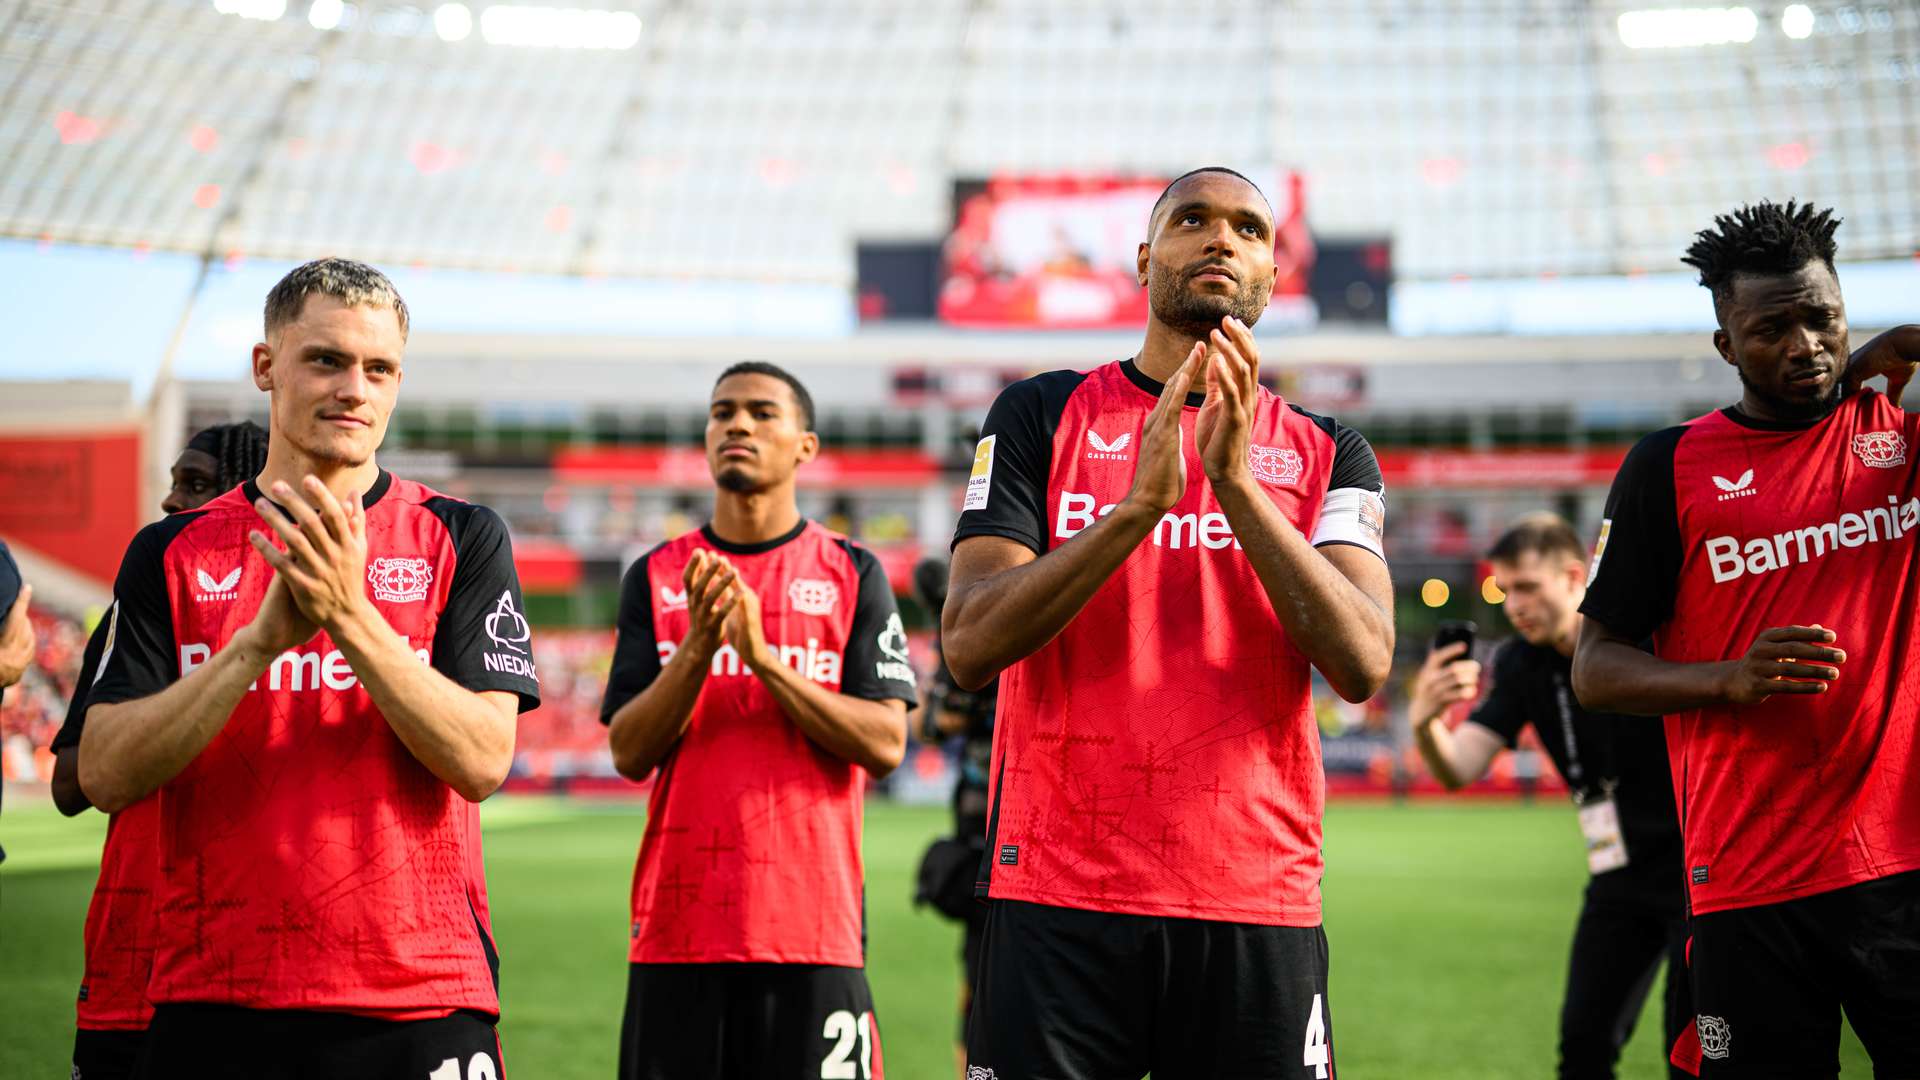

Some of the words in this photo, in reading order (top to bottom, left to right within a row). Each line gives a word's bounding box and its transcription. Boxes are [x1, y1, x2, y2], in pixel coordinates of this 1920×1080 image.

[1088, 452, 1128, 461] CASTORE
[1718, 488, 1757, 501] CASTORE
[1705, 495, 1920, 584] Barmenia
[196, 592, 238, 602] CASTORE
[821, 1010, 872, 1079] 21
[1304, 993, 1329, 1079] 4
